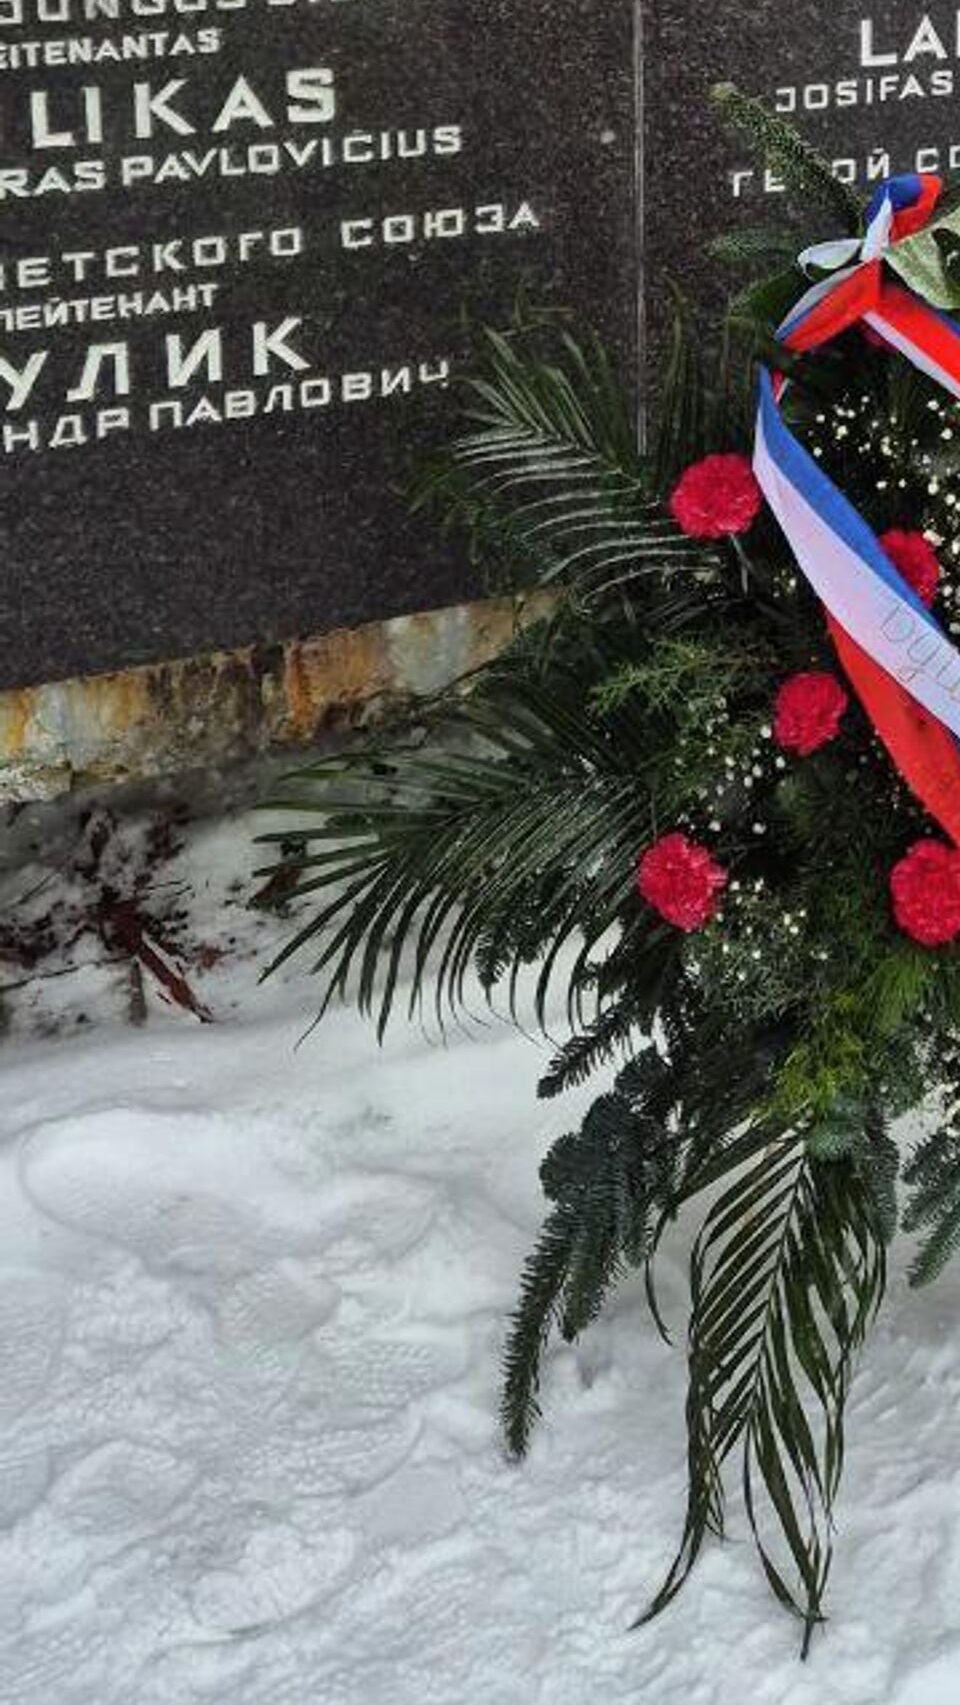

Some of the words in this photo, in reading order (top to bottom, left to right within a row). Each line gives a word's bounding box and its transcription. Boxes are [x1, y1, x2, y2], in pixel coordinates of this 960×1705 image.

[775, 71, 955, 113] JOSIFAS
[0, 226, 302, 289] ЕТСКОГО
[340, 201, 541, 249] СОЮЗА
[150, 360, 450, 432] ПАВЛОВИЧ
